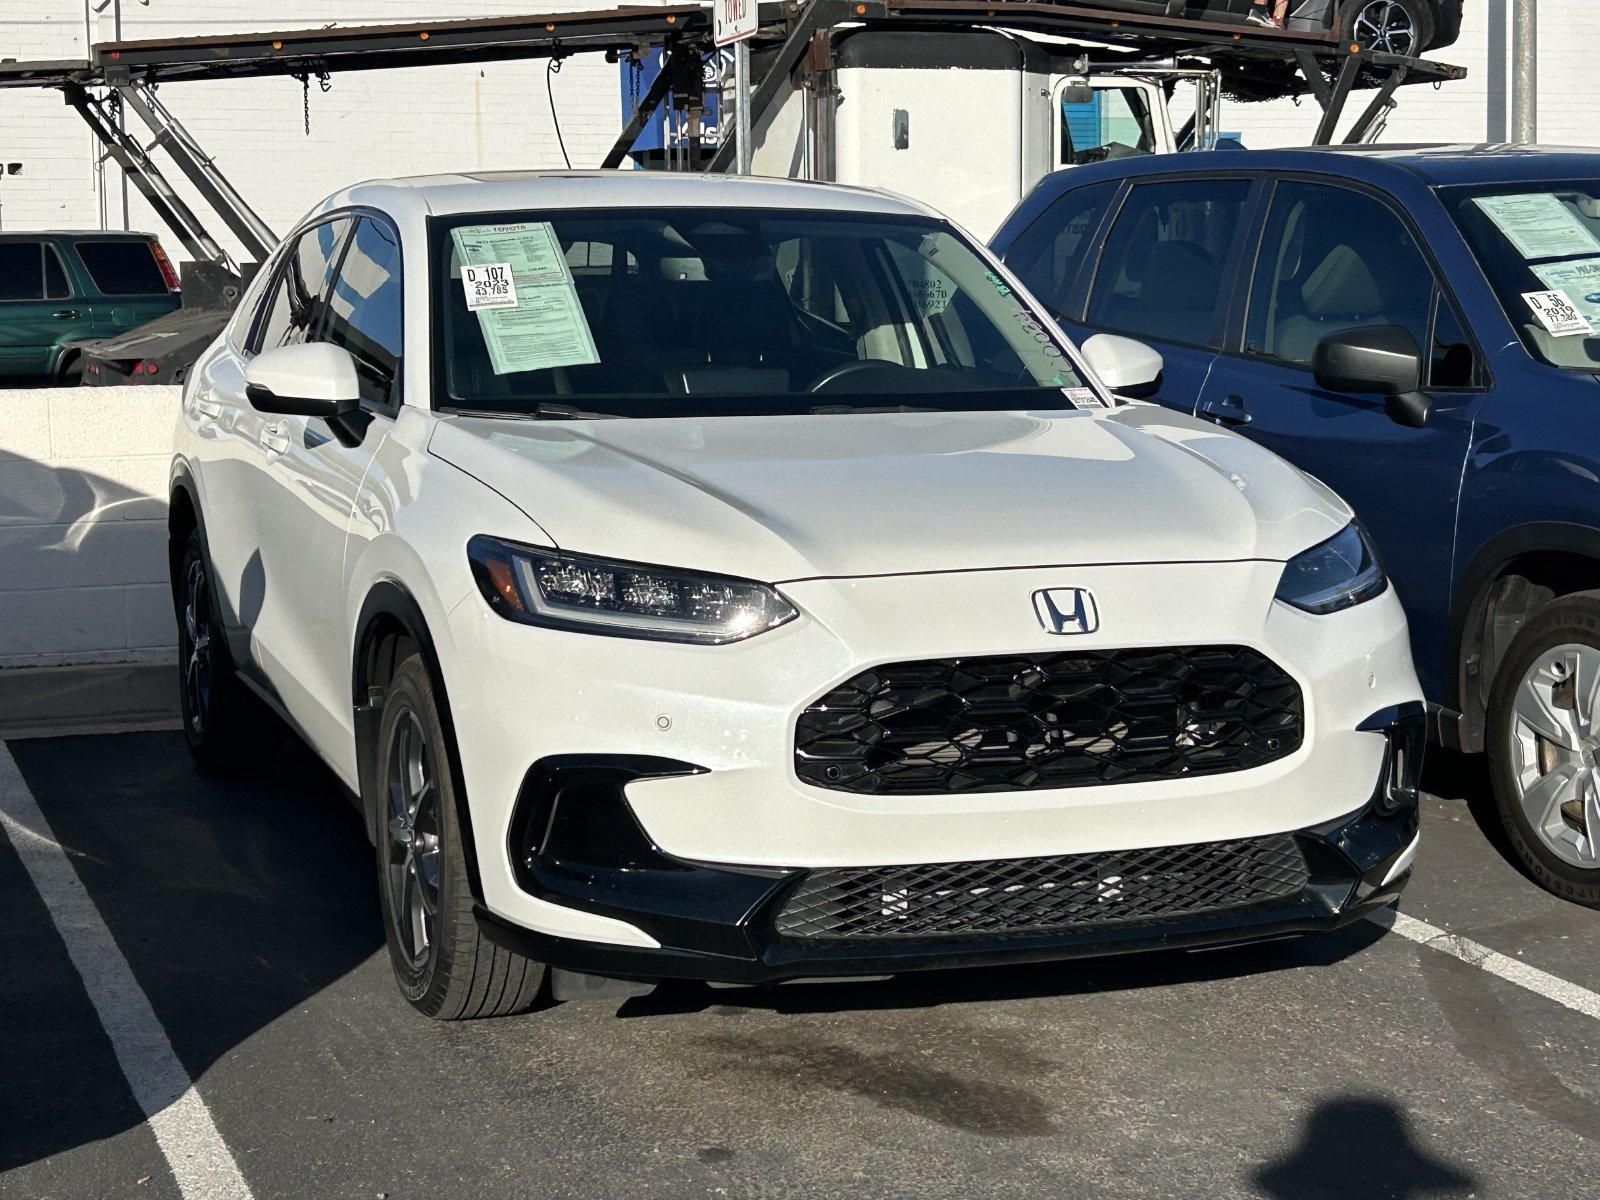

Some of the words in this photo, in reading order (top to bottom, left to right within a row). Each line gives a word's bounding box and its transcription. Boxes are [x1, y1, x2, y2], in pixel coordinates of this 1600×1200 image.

[467, 268, 476, 282] D
[484, 267, 504, 281] 107
[474, 279, 510, 289] 2023
[1529, 296, 1543, 309] D
[1546, 293, 1565, 307] 56
[1543, 305, 1575, 316] 2019
